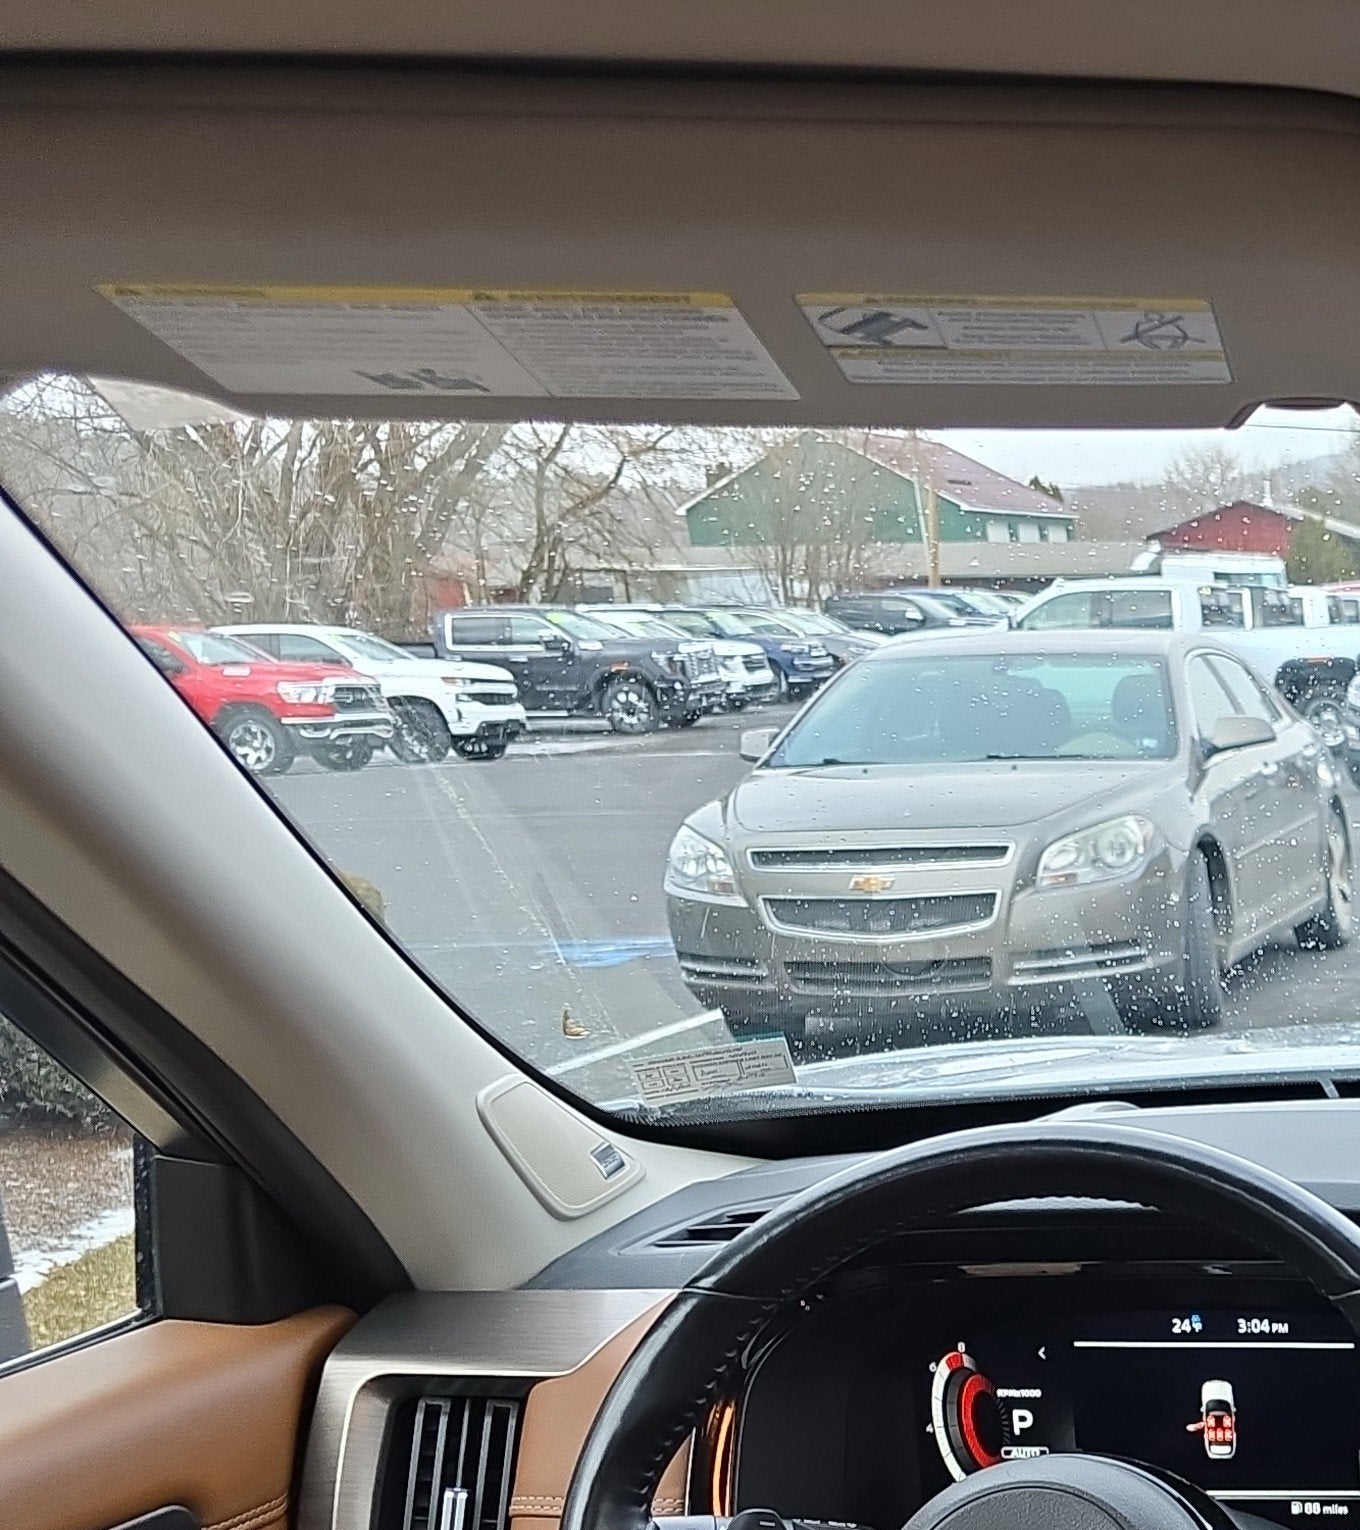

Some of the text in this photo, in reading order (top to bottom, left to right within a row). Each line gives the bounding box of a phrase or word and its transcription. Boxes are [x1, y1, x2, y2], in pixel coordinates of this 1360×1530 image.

[1237, 1318, 1289, 1334] 3:04 PM
[1012, 1408, 1034, 1436] P
[1322, 1503, 1349, 1516] miles
